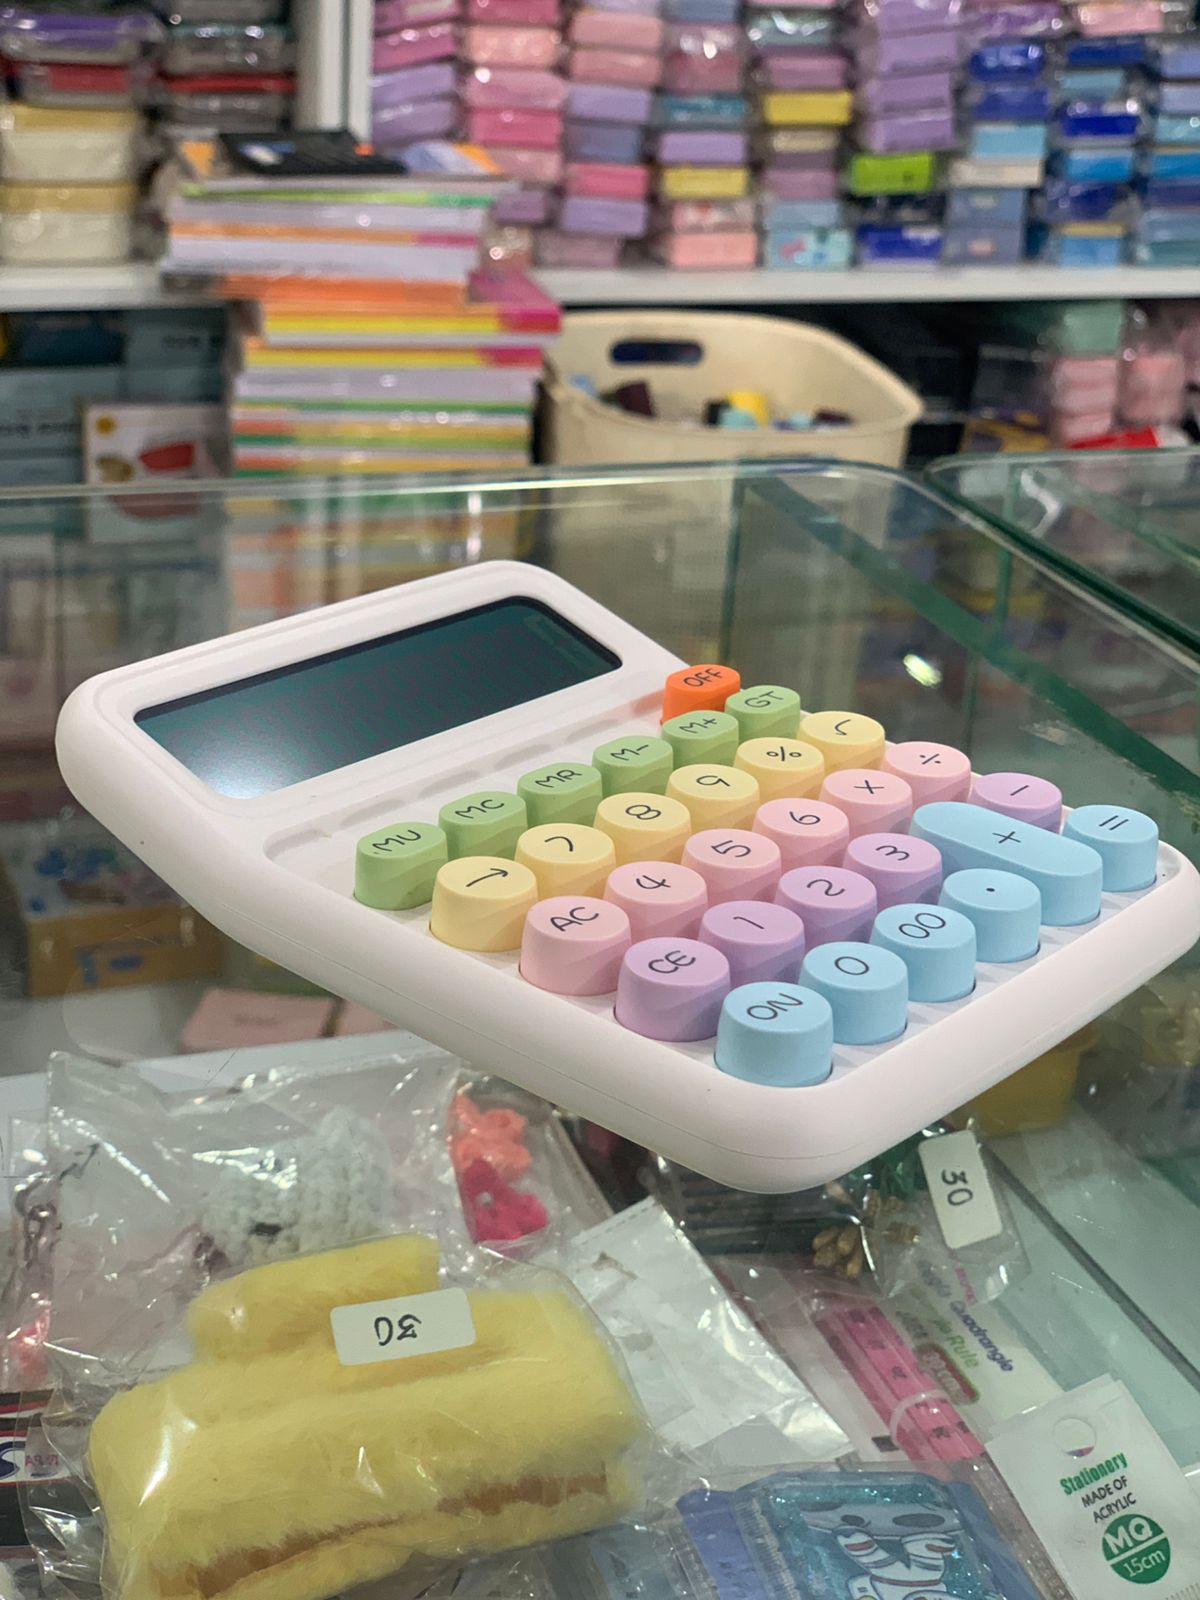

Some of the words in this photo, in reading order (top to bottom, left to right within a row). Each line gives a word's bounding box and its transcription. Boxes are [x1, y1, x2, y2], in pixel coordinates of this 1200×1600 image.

[683, 668, 724, 687] OFF
[743, 690, 784, 708] GT
[678, 716, 717, 733] M+
[610, 745, 650, 761] M-
[535, 769, 583, 789] MR
[695, 775, 732, 788] 9
[455, 799, 505, 820] MC
[625, 804, 663, 821] 8
[788, 810, 822, 826] 6
[373, 830, 422, 853] MU
[543, 835, 575, 853] 7
[710, 839, 752, 858] 5
[874, 844, 911, 862] 3
[635, 874, 672, 890] 4
[805, 878, 846, 897] 2
[550, 906, 600, 932] AC
[732, 915, 766, 930] 1
[897, 912, 947, 940] 00
[648, 949, 697, 975] CE
[834, 955, 871, 976] 0
[746, 992, 804, 1021] ON
[941, 1169, 974, 1207] 30
[374, 1313, 422, 1347] 30
[951, 1301, 1013, 1371] Quadrangle
[948, 1334, 978, 1368] Rule
[1060, 1453, 1128, 1496] Stationery
[1081, 1483, 1113, 1508] MADE
[1113, 1475, 1128, 1491] OF
[1093, 1492, 1136, 1523] ACRYLIC
[1104, 1517, 1152, 1555] MQ
[1123, 1550, 1166, 1577] 15cm
